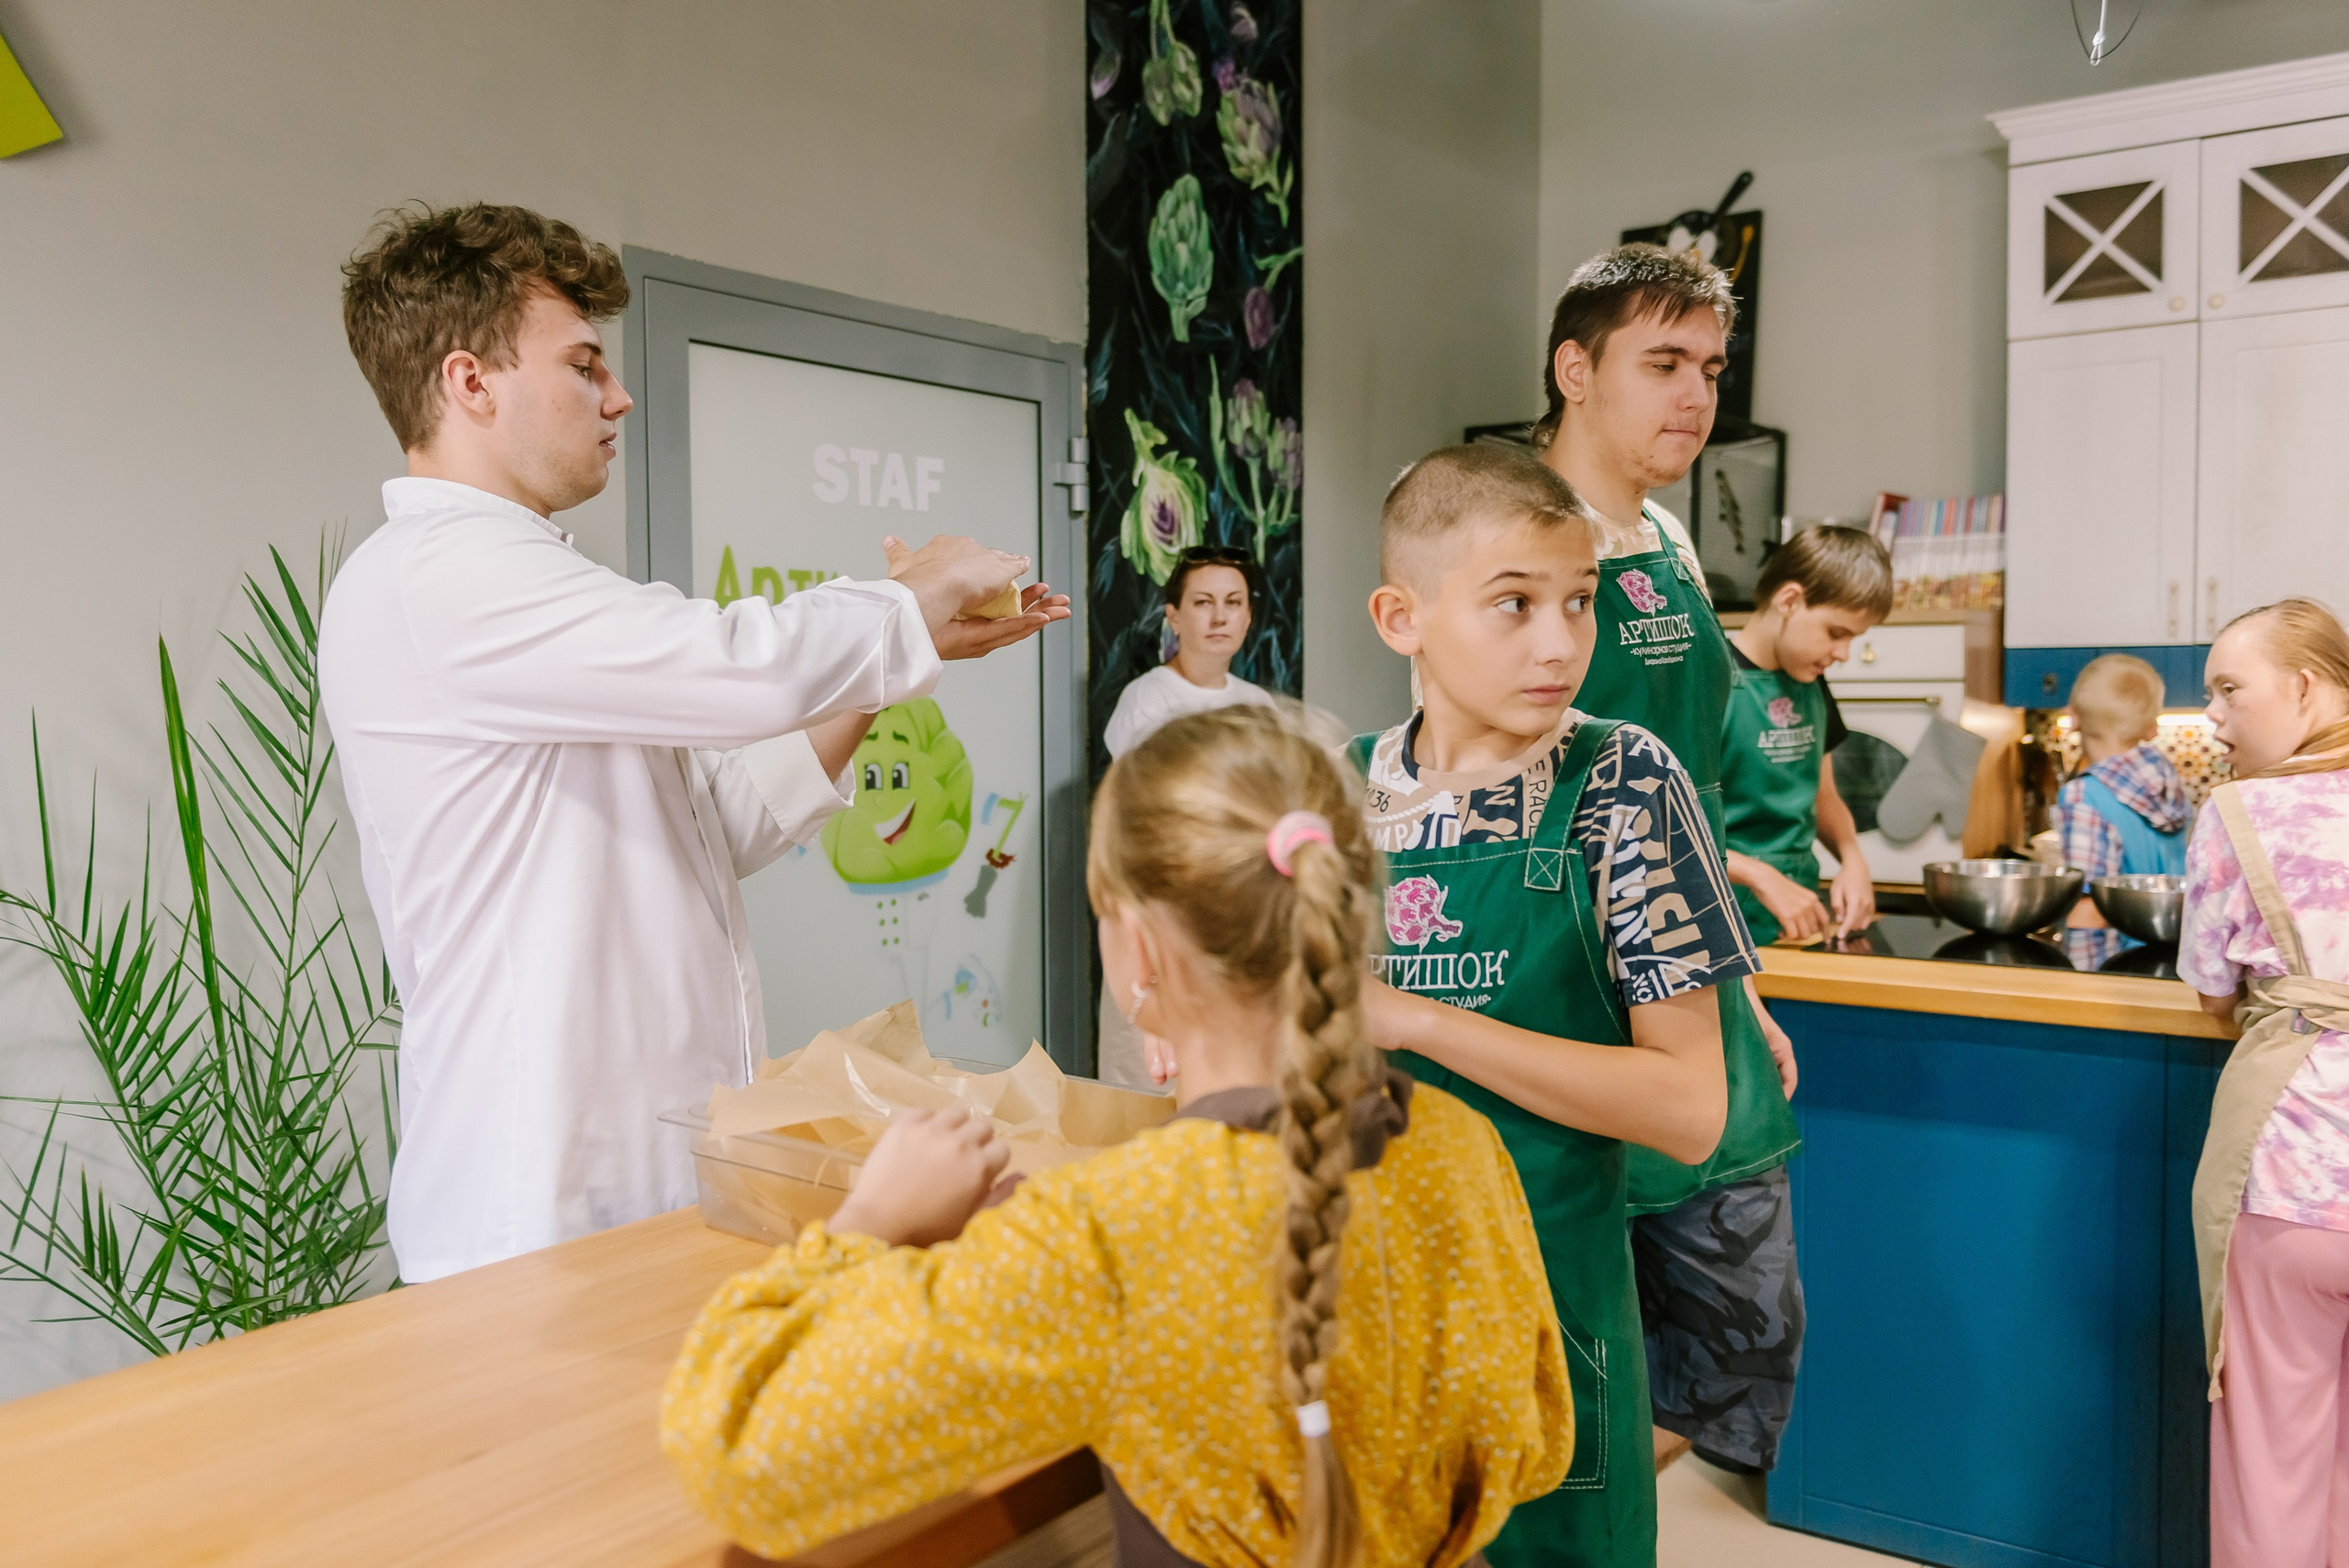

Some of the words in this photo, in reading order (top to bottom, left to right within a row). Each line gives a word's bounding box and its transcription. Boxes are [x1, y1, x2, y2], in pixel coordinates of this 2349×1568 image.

[812, 444, 944, 513] STAF
[1619, 613, 1695, 645] АРТИШОК
[1368, 950, 1509, 990] РТИШОК
